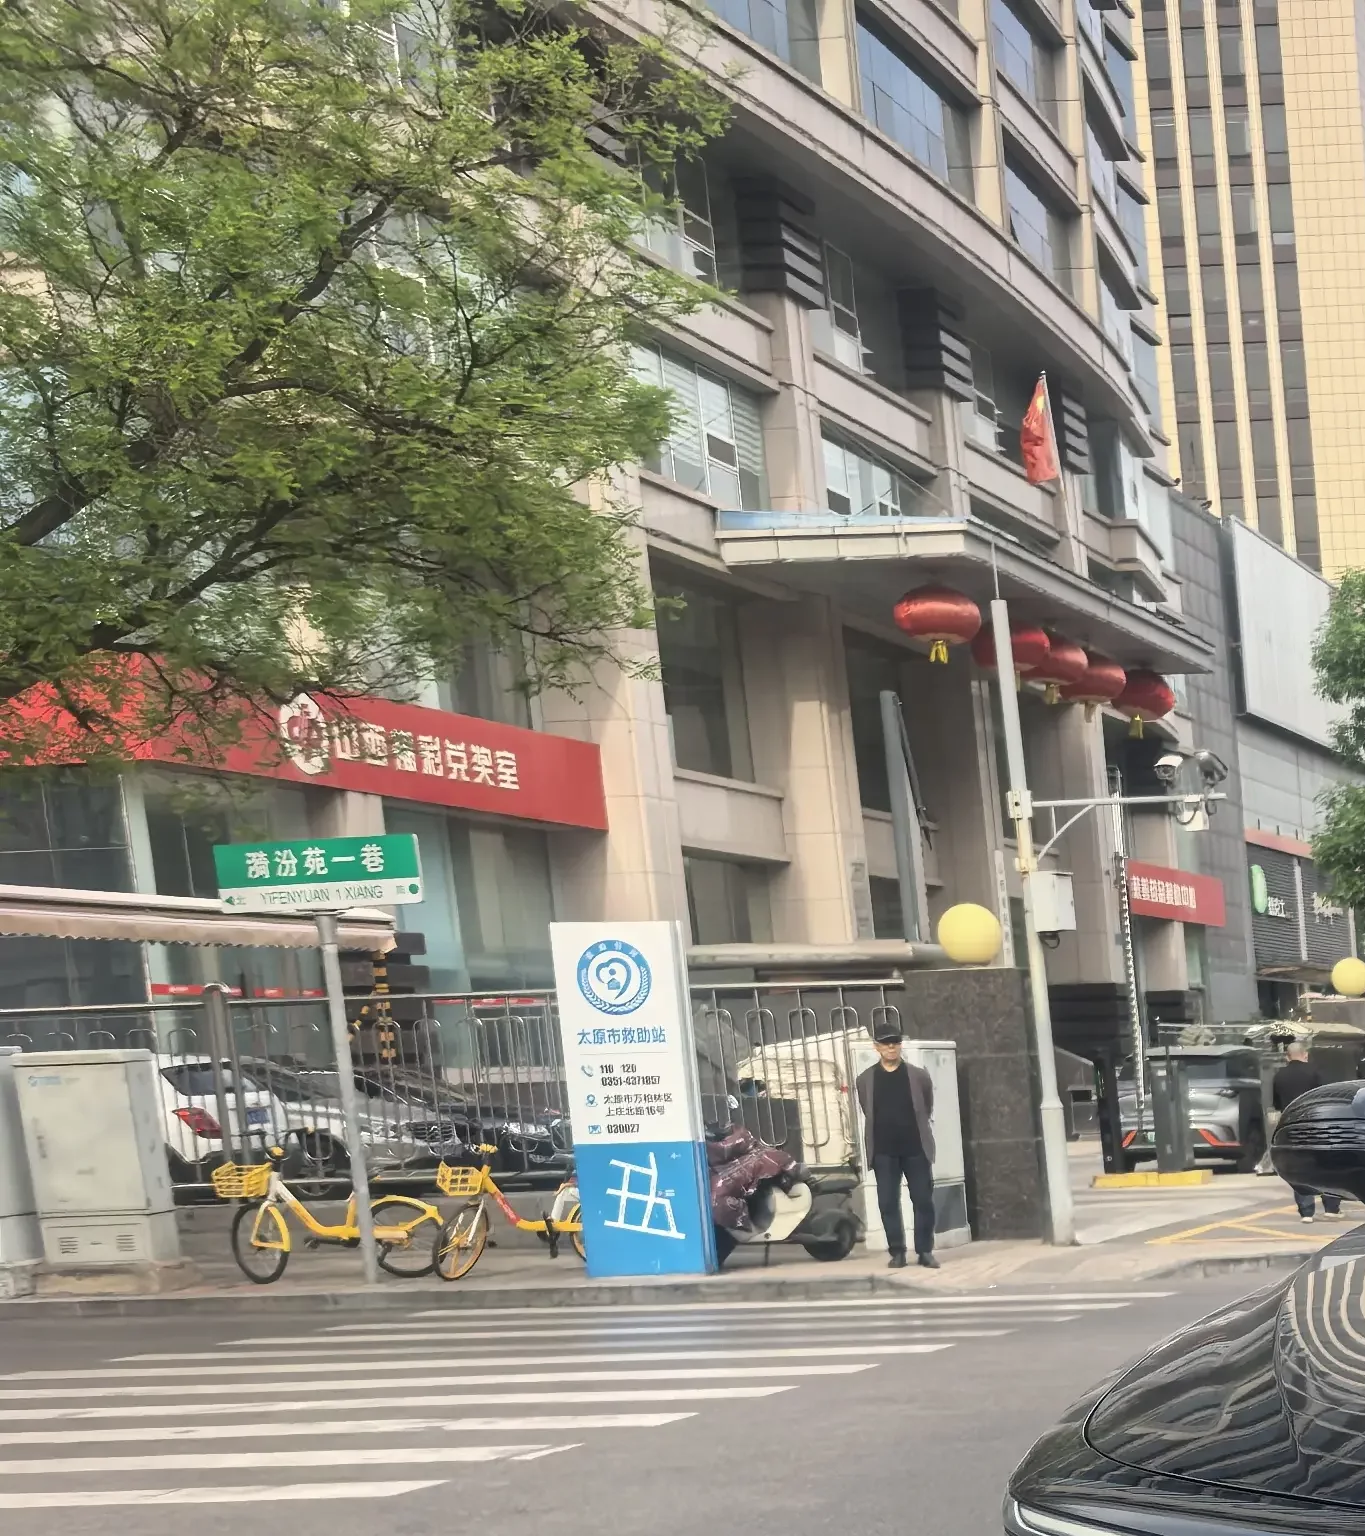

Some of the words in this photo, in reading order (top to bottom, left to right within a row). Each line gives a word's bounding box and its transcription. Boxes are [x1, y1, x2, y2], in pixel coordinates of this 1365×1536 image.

[345, 885, 384, 899] XIANG
[577, 1025, 667, 1045] 太原市救助站
[620, 1063, 637, 1073] 120
[606, 1123, 640, 1134] 030027
